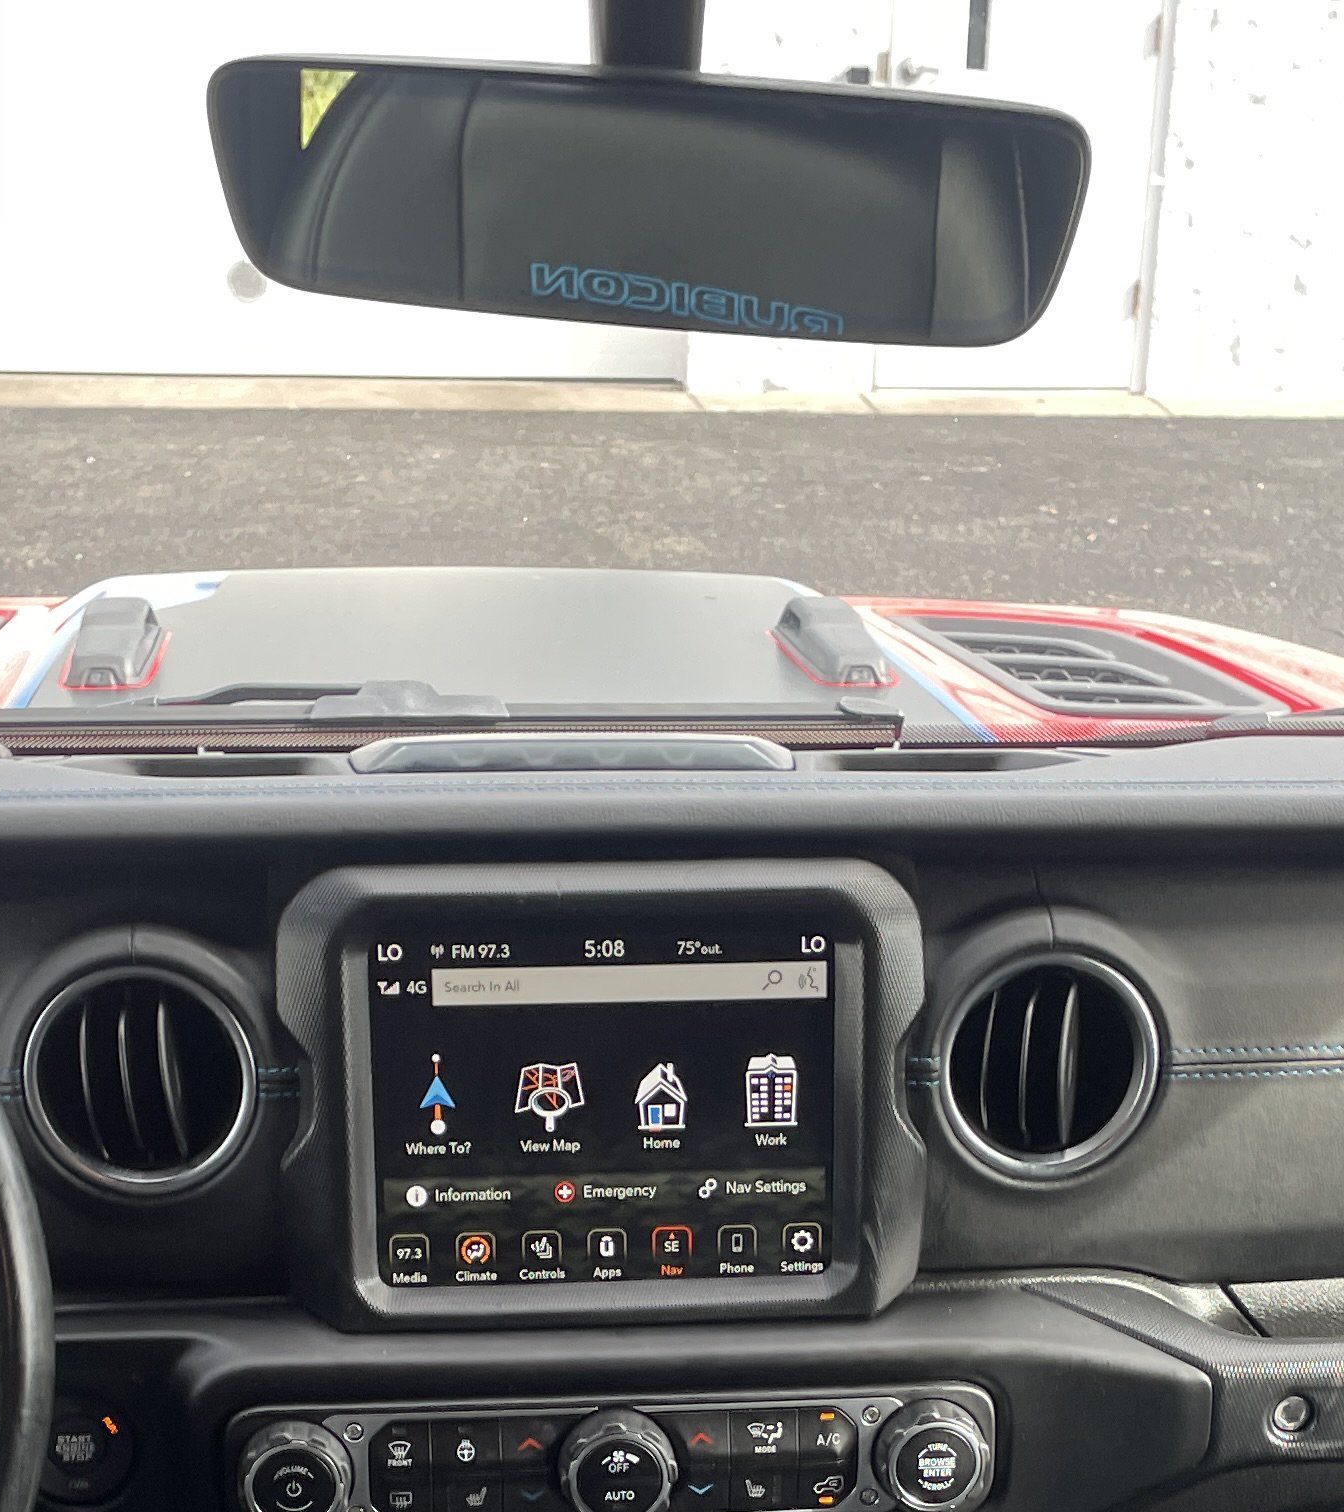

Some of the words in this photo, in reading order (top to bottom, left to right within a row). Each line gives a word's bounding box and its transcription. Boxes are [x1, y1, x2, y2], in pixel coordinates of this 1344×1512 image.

[584, 939, 625, 958] 5:08
[801, 935, 825, 953] LO
[377, 944, 402, 961] LO
[451, 944, 474, 959] FM
[477, 943, 510, 959] 97.3
[406, 980, 427, 994] 4G
[444, 980, 486, 993] Search
[489, 980, 501, 993] In
[505, 979, 520, 992] All
[520, 1140, 550, 1153] View
[552, 1139, 581, 1154] Map
[643, 1137, 681, 1149] Home
[755, 1133, 787, 1147] Work
[405, 1142, 446, 1155] Where
[449, 1141, 471, 1155] To?
[583, 1184, 657, 1200] Emergency
[725, 1181, 752, 1194] Nav
[755, 1179, 807, 1195] Settings
[434, 1187, 511, 1202] Information
[664, 1240, 680, 1253] SE
[396, 1248, 423, 1260] 97.3
[519, 1267, 566, 1280] Controls
[593, 1266, 622, 1280] Apps
[660, 1264, 683, 1276] Nav
[719, 1262, 755, 1274] Phone
[780, 1260, 824, 1274] Settings
[392, 1272, 428, 1284] Media
[455, 1270, 498, 1282] Climate
[816, 1433, 841, 1446] A/C
[754, 1445, 777, 1454] MODE
[927, 1442, 949, 1451] TUNE
[387, 1459, 413, 1467] FRONT
[608, 1463, 630, 1473] OFF
[918, 1457, 956, 1468] BROWSE
[276, 1464, 309, 1477] VOLUME
[922, 1469, 952, 1477] ENTER
[921, 1480, 953, 1491] SCROLL
[604, 1490, 635, 1501] AUTO
